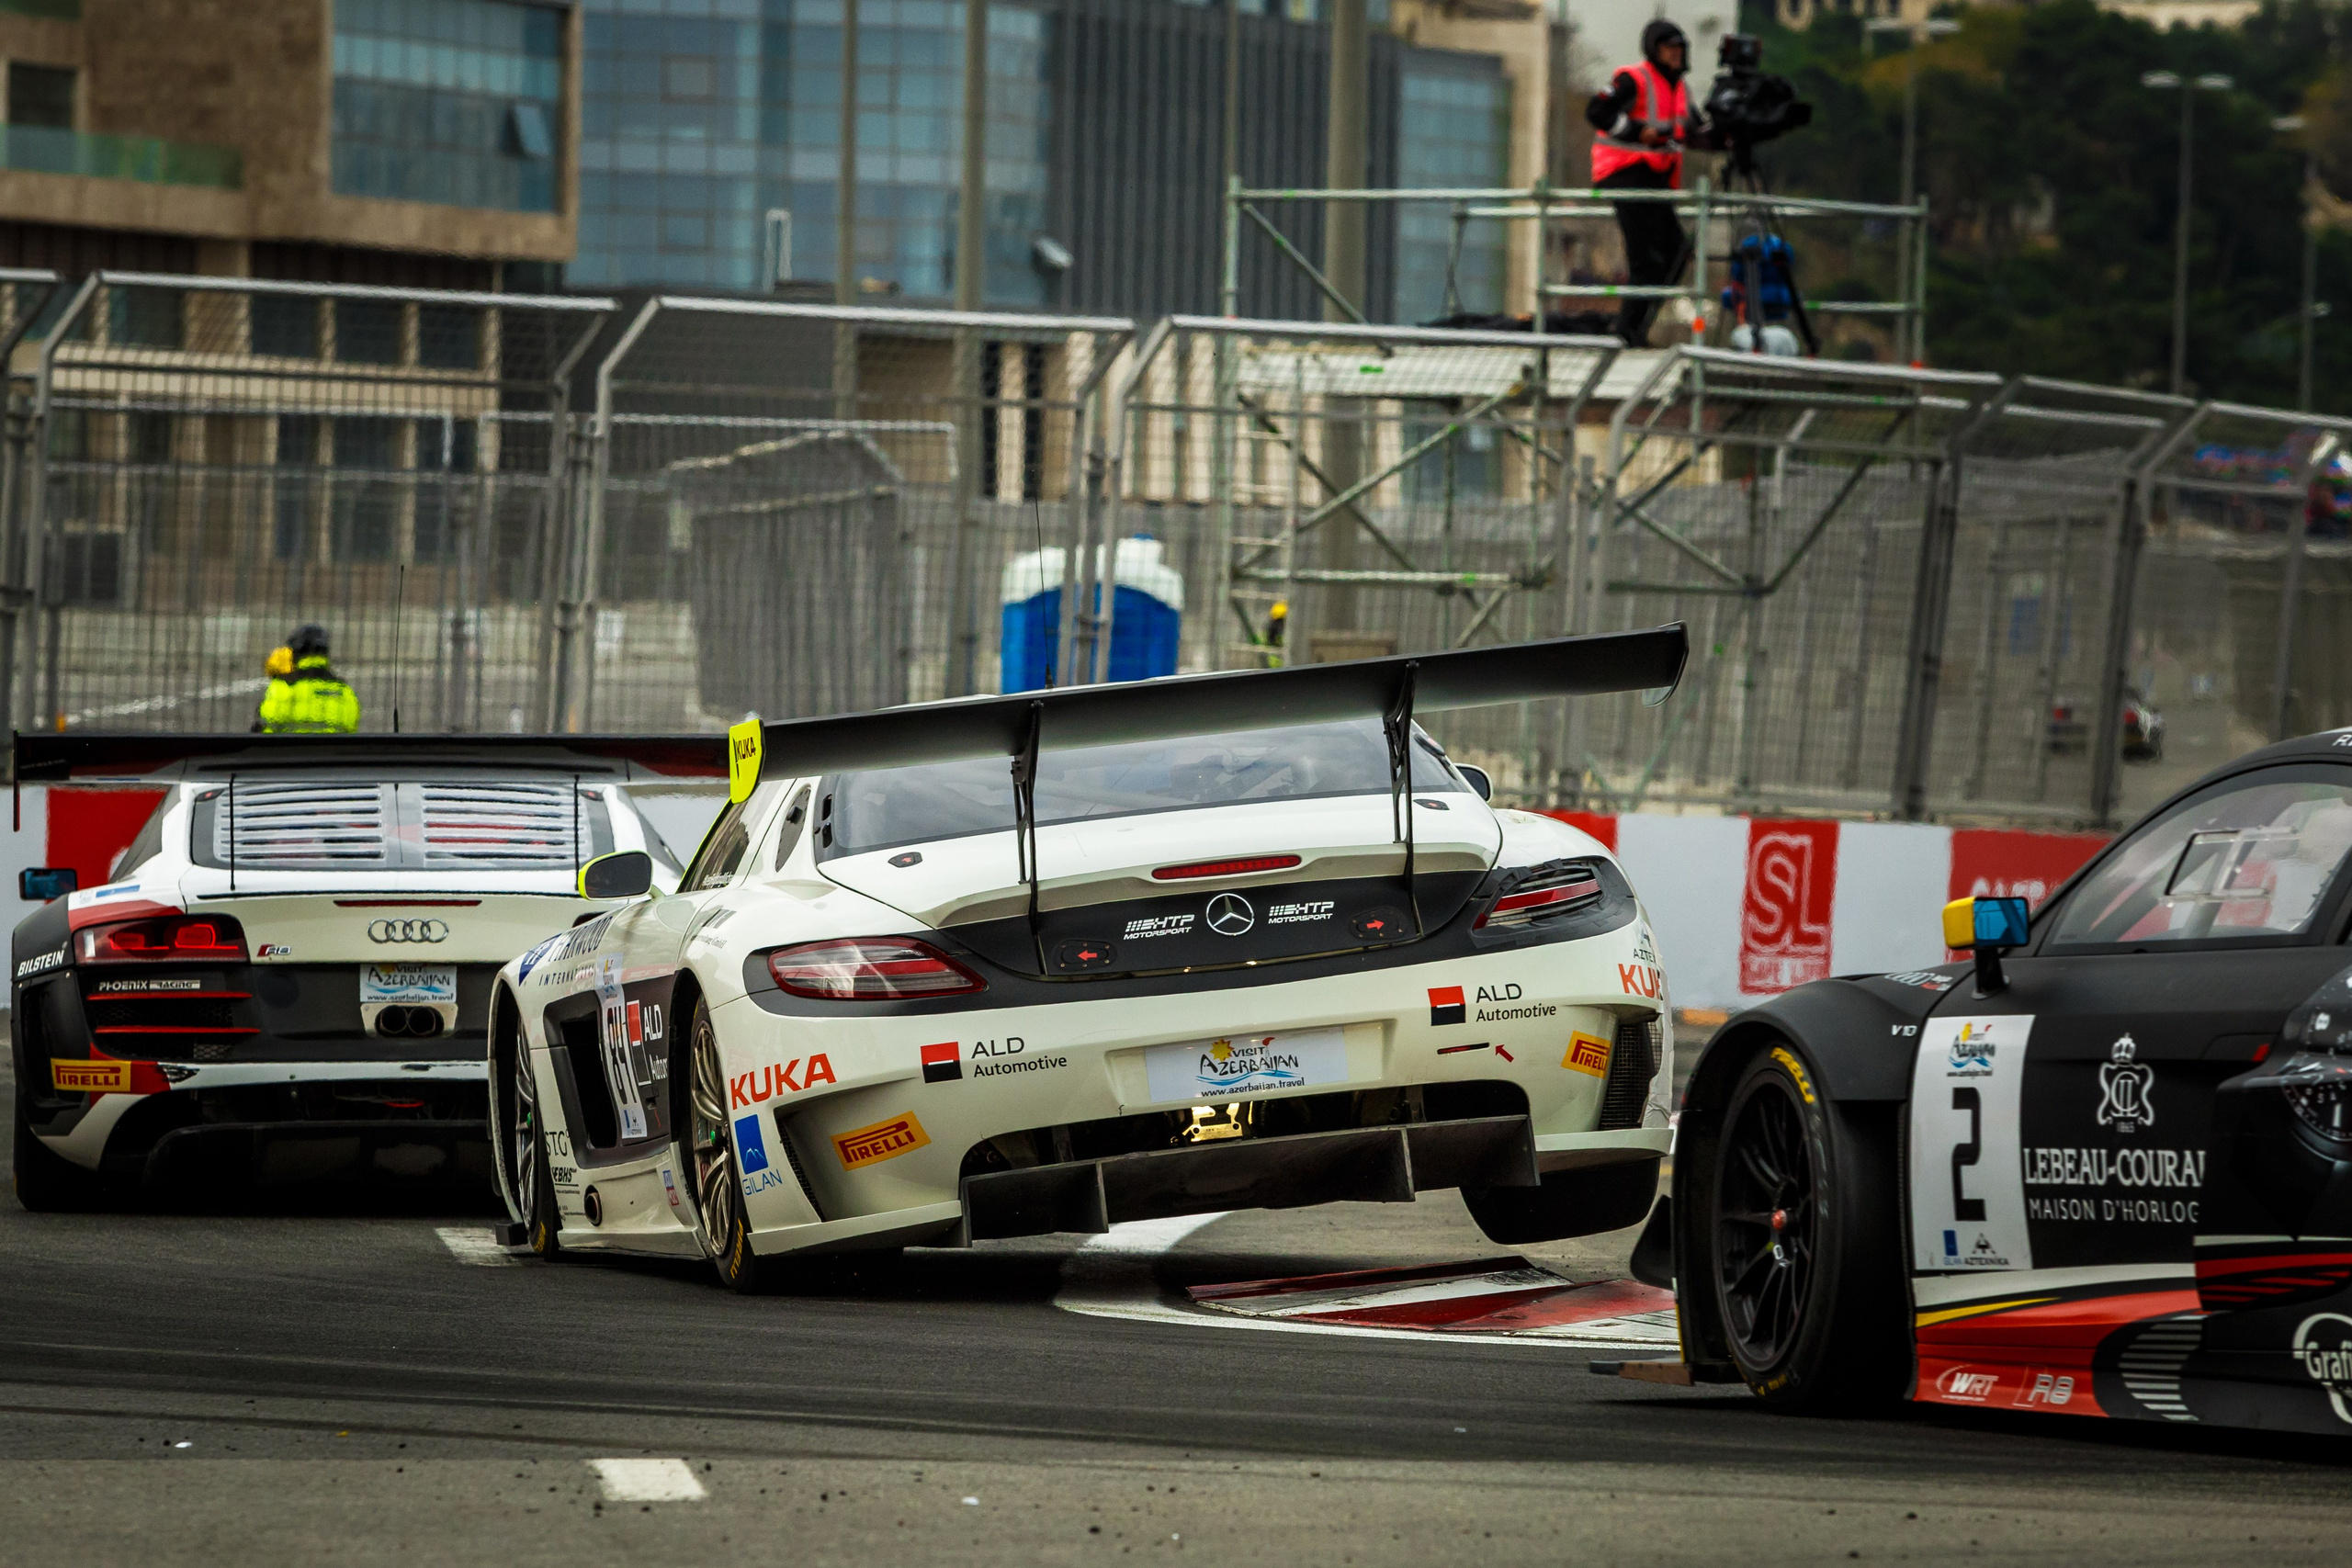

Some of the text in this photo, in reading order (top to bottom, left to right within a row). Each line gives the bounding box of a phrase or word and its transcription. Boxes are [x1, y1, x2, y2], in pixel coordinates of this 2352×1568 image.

[736, 737, 756, 761] KUKA
[1268, 912, 1333, 924] MOTORSPORT
[1124, 926, 1192, 941] MOTORSPORT
[17, 949, 65, 976] BILSTEIN
[1476, 983, 1522, 1003] ALD
[644, 1004, 662, 1041] ALD
[1476, 1003, 1556, 1022] Automotive
[970, 1036, 1024, 1059] ALD
[1232, 1046, 1266, 1058] VISIT
[54, 1064, 121, 1086] PIRELLI
[973, 1055, 1068, 1078] Automotive
[729, 1053, 837, 1110] KUKA
[1201, 1077, 1305, 1097] www.azerbaijan.travel
[838, 1120, 917, 1164] PIRELLI
[1951, 1087, 1986, 1222] 2
[741, 1168, 783, 1196] GILAN
[2029, 1198, 2096, 1221] MAISON
[1949, 1372, 1999, 1396] WRT
[2028, 1373, 2075, 1404] R8
